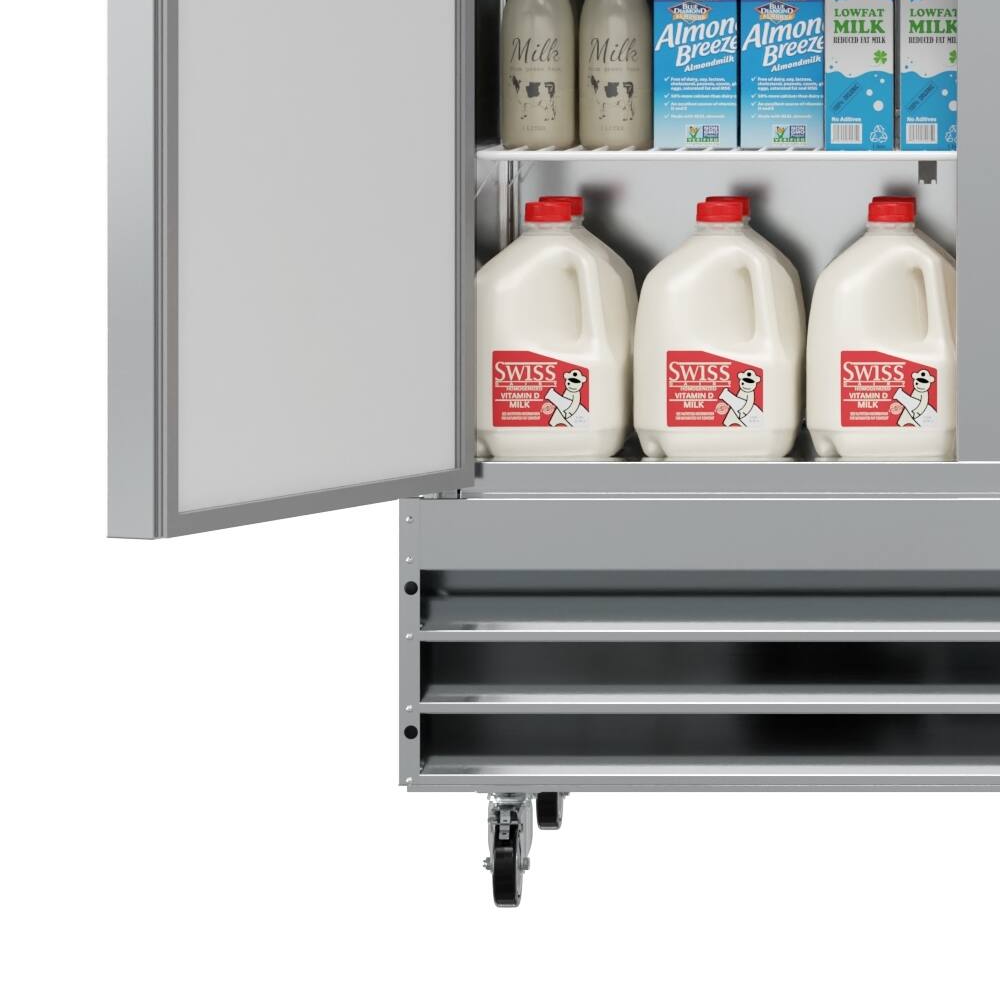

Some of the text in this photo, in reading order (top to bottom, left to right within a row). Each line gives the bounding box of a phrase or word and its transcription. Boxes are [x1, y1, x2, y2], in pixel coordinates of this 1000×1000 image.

[834, 8, 885, 17] LOWFAT
[655, 17, 737, 51] Almon
[741, 17, 824, 51] Almon
[833, 20, 886, 34] MILK
[909, 20, 958, 34] MILK
[833, 36, 886, 44] REDUCED FAT MILK
[908, 36, 934, 44] REDUCED
[935, 36, 945, 44] FAT
[510, 37, 560, 64] Milk
[589, 37, 638, 64] Milk
[676, 36, 737, 67] Breeze
[762, 36, 824, 67] Breeze
[684, 55, 735, 72] Almondmilk
[770, 55, 822, 72] Almondmilk
[495, 361, 556, 381] SWISS
[669, 361, 730, 381] SWISS
[843, 361, 904, 381] SWISS
[509, 401, 530, 409] MILK
[683, 401, 704, 409] MILK
[857, 401, 878, 409] MILK
